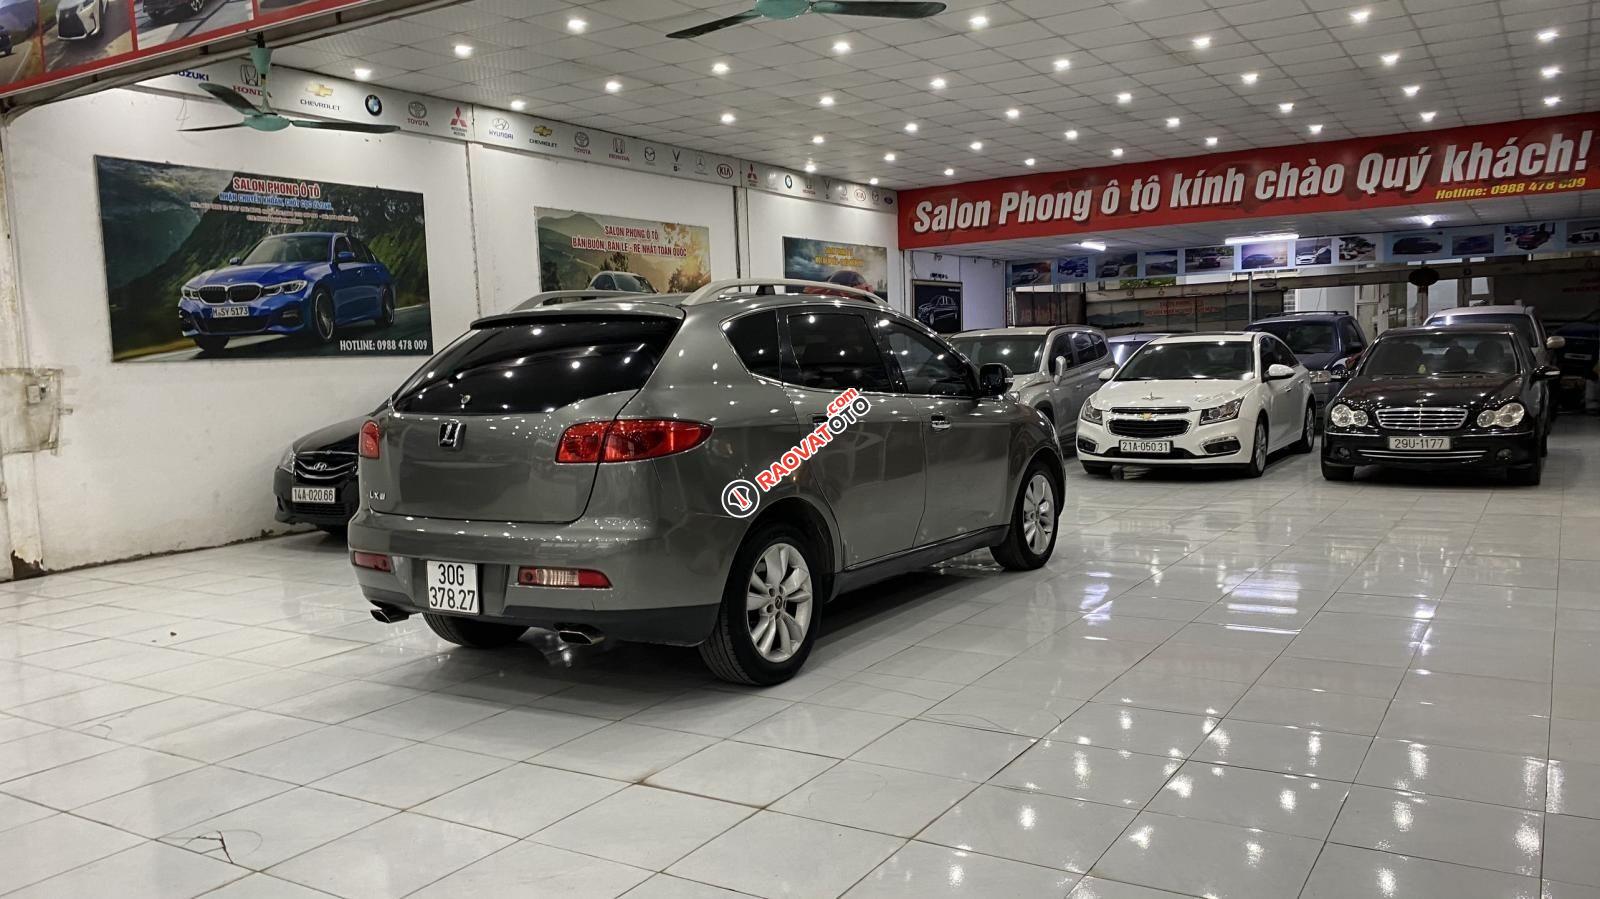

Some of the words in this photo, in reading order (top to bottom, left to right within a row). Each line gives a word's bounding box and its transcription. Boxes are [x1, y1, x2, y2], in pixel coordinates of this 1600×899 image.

[300, 99, 342, 112] CHEVROLET
[408, 117, 430, 127] TOYOTA
[529, 138, 557, 148] CHEVROLET
[609, 153, 630, 162] HONDA
[233, 177, 266, 194] SALON
[267, 181, 299, 197] PHONG
[299, 183, 309, 198] Ô
[307, 184, 320, 199] TÔ
[913, 199, 991, 233] Salon
[999, 188, 1092, 224] Phong
[1101, 179, 1121, 215] ô
[1131, 175, 1161, 212] tô
[1170, 168, 1245, 207] kính
[1255, 159, 1344, 200] chào
[1356, 147, 1433, 194] Quý
[1440, 130, 1593, 183] khách!
[1435, 187, 1487, 200] Hotline:
[1490, 183, 1525, 195] 0988
[605, 226, 625, 236] SALON
[626, 228, 645, 239] PHONG
[231, 307, 249, 317] 5173
[340, 339, 376, 351] HOTLINE:
[377, 340, 397, 350] 0988
[398, 340, 412, 350] 478
[413, 340, 428, 350] 009
[1394, 438, 1444, 449] 29U-1177
[293, 488, 334, 501] 14A-020.66
[438, 563, 465, 586] 30G
[429, 586, 476, 611] 378.27
